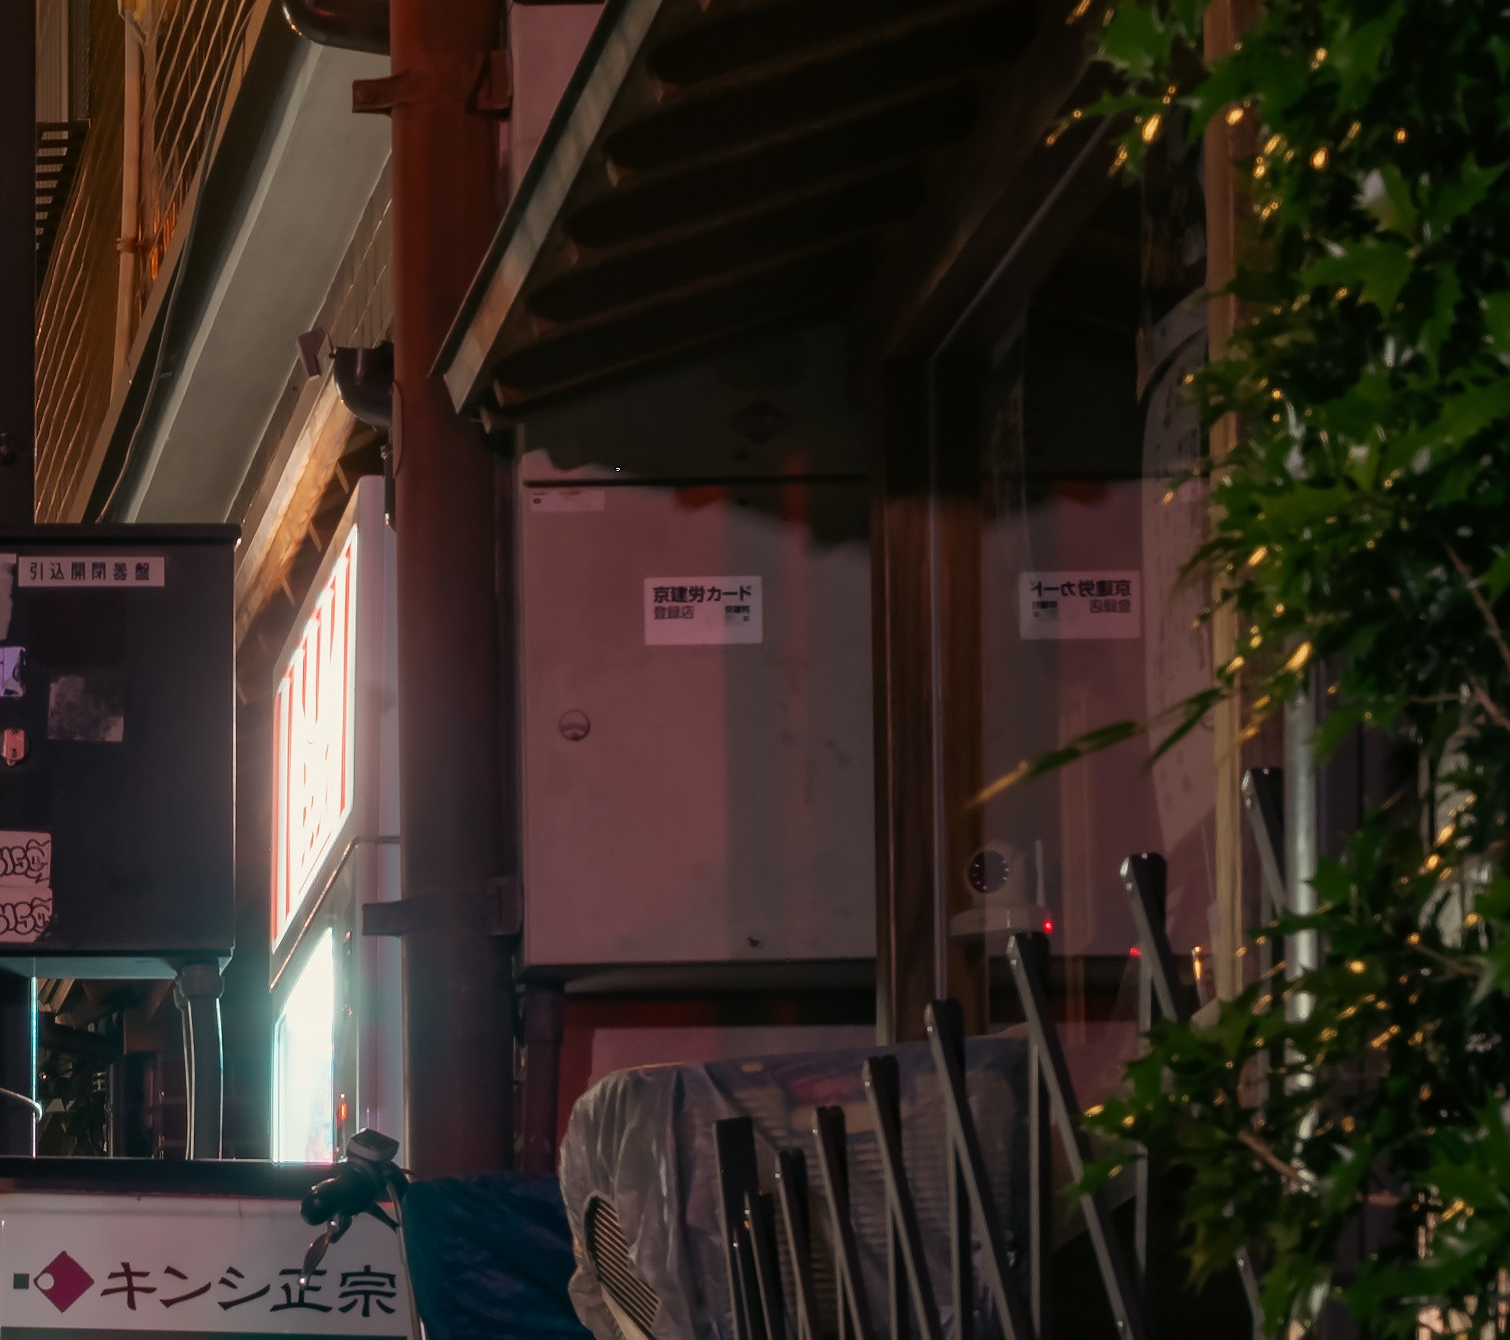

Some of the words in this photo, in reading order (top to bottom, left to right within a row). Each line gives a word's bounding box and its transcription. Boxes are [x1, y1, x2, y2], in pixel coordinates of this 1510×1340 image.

[99, 1260, 397, 1317] キンシ正宗
